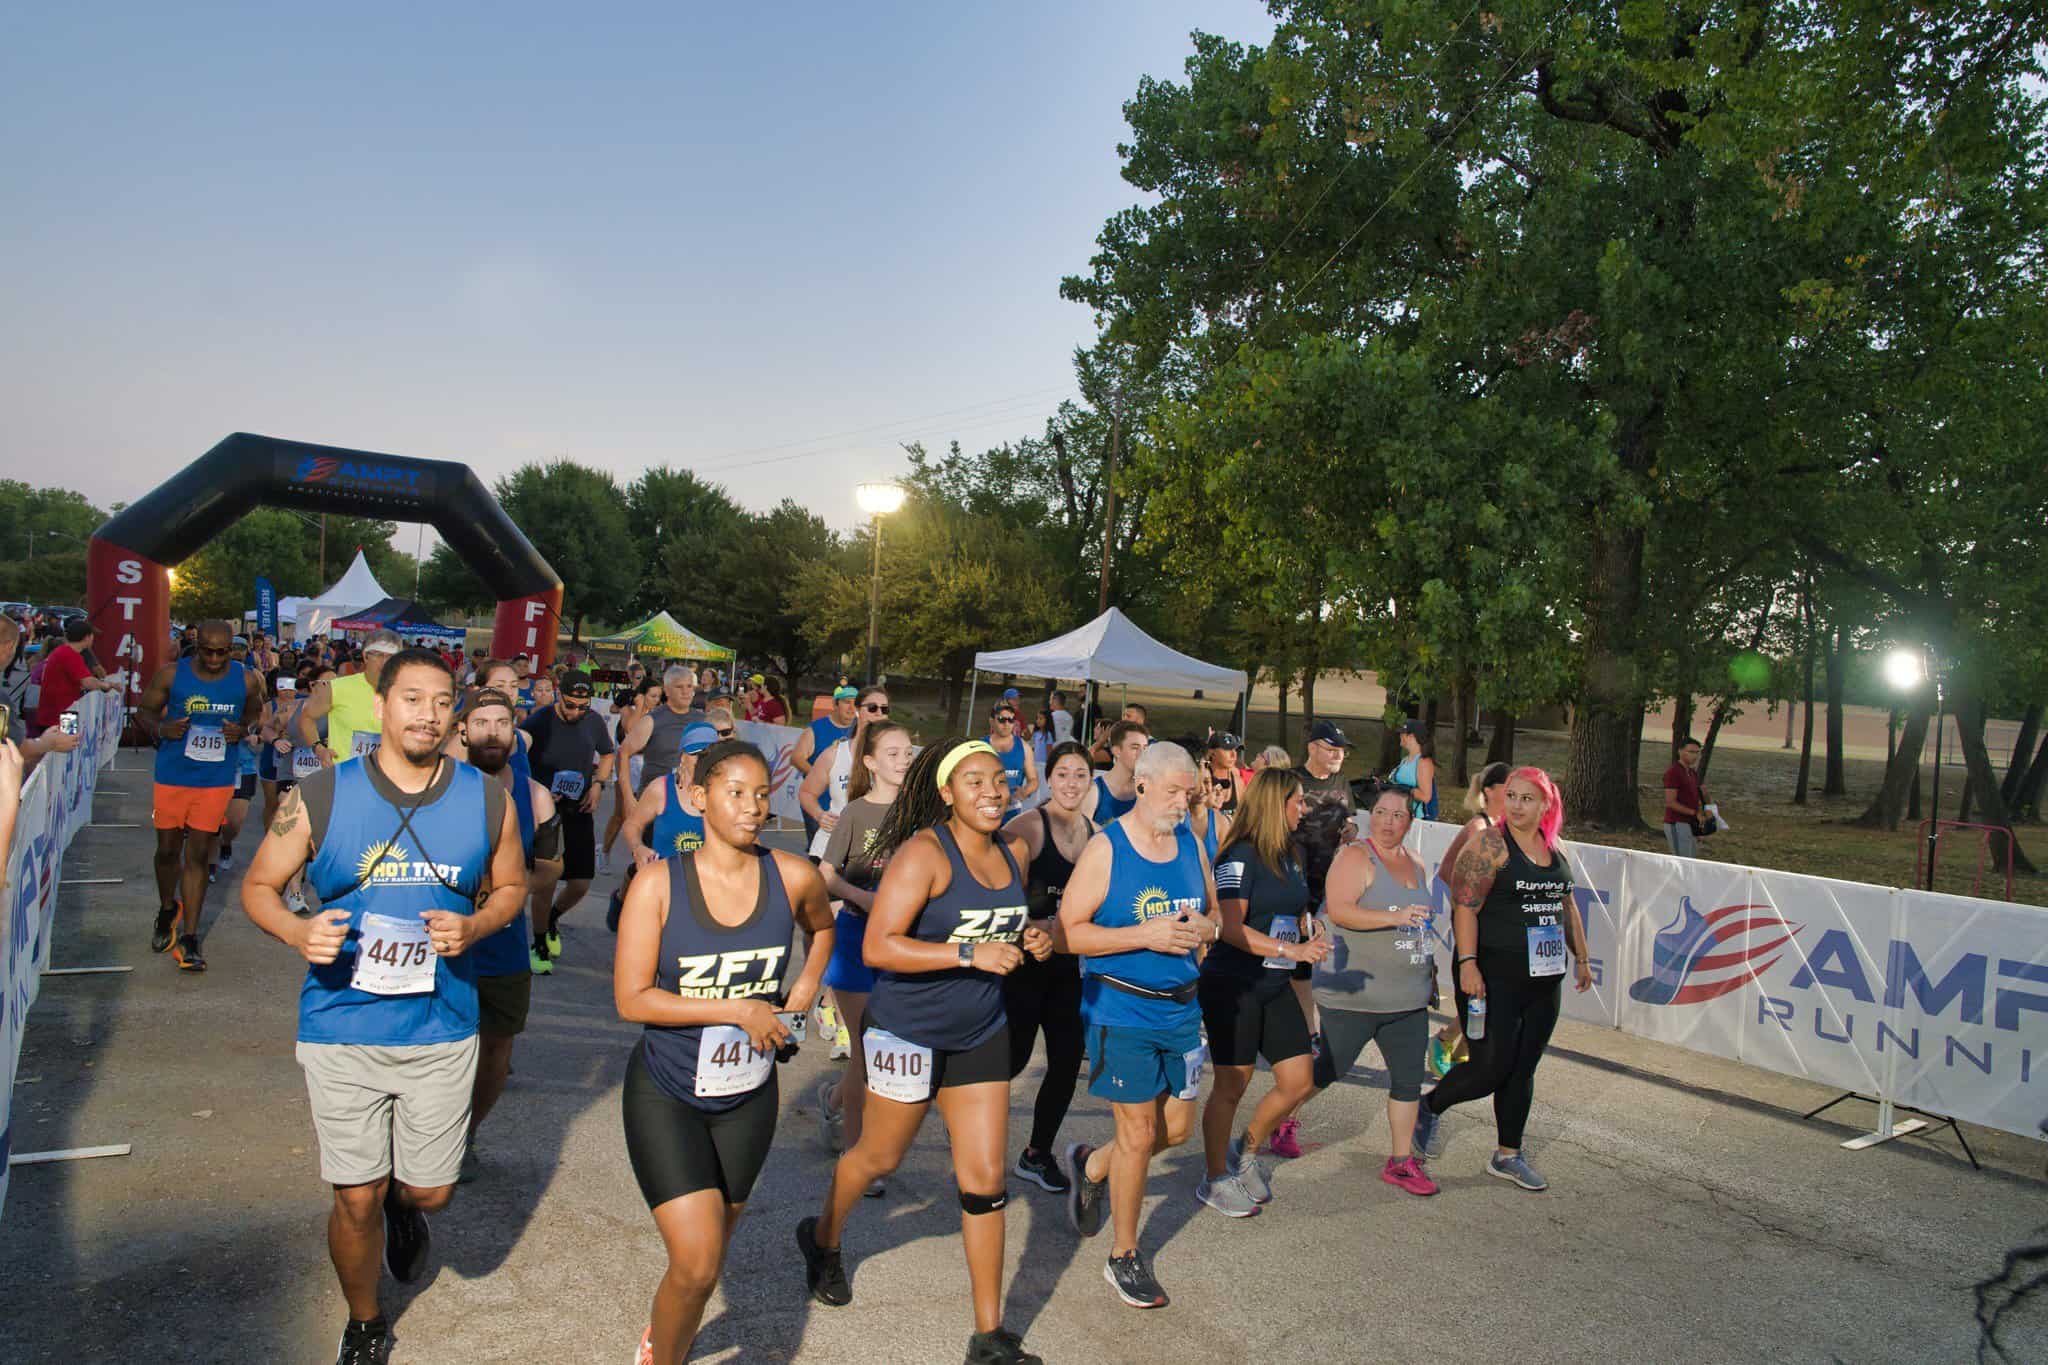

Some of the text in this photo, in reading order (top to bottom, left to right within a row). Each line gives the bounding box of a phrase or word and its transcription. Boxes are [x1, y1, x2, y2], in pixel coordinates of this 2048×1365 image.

[192, 703, 210, 711] HOT
[191, 735, 222, 750] 4315
[683, 841, 704, 849] HOT
[372, 861, 410, 878] HOT
[1515, 880, 1565, 894] Running
[1146, 901, 1171, 915] HOT
[367, 938, 428, 967] 4475
[1535, 940, 1563, 958] 4089
[678, 946, 786, 988] ZFT
[873, 1051, 922, 1077] 4410
